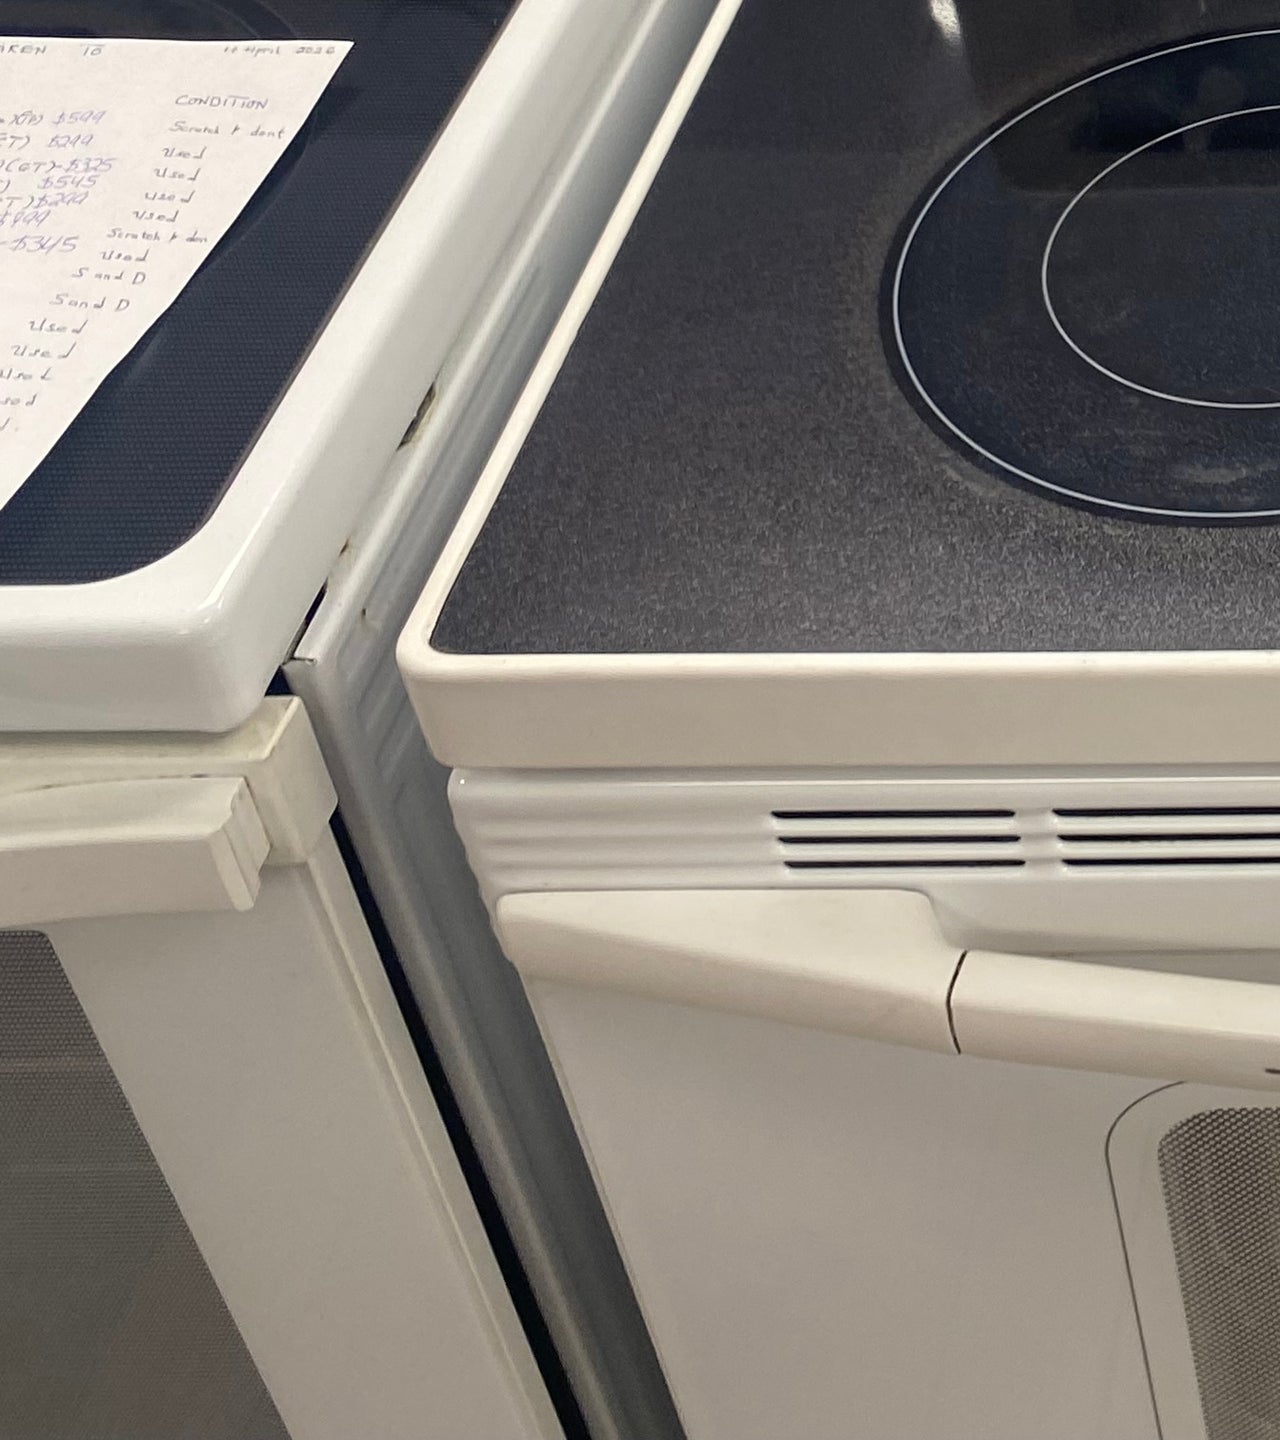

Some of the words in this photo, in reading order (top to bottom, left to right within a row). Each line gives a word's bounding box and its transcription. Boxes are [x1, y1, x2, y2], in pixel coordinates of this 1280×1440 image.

[175, 94, 269, 110] CONDITION
[154, 167, 202, 181] Used
[132, 271, 147, 285] D
[115, 298, 131, 312] D
[28, 317, 89, 335] Used
